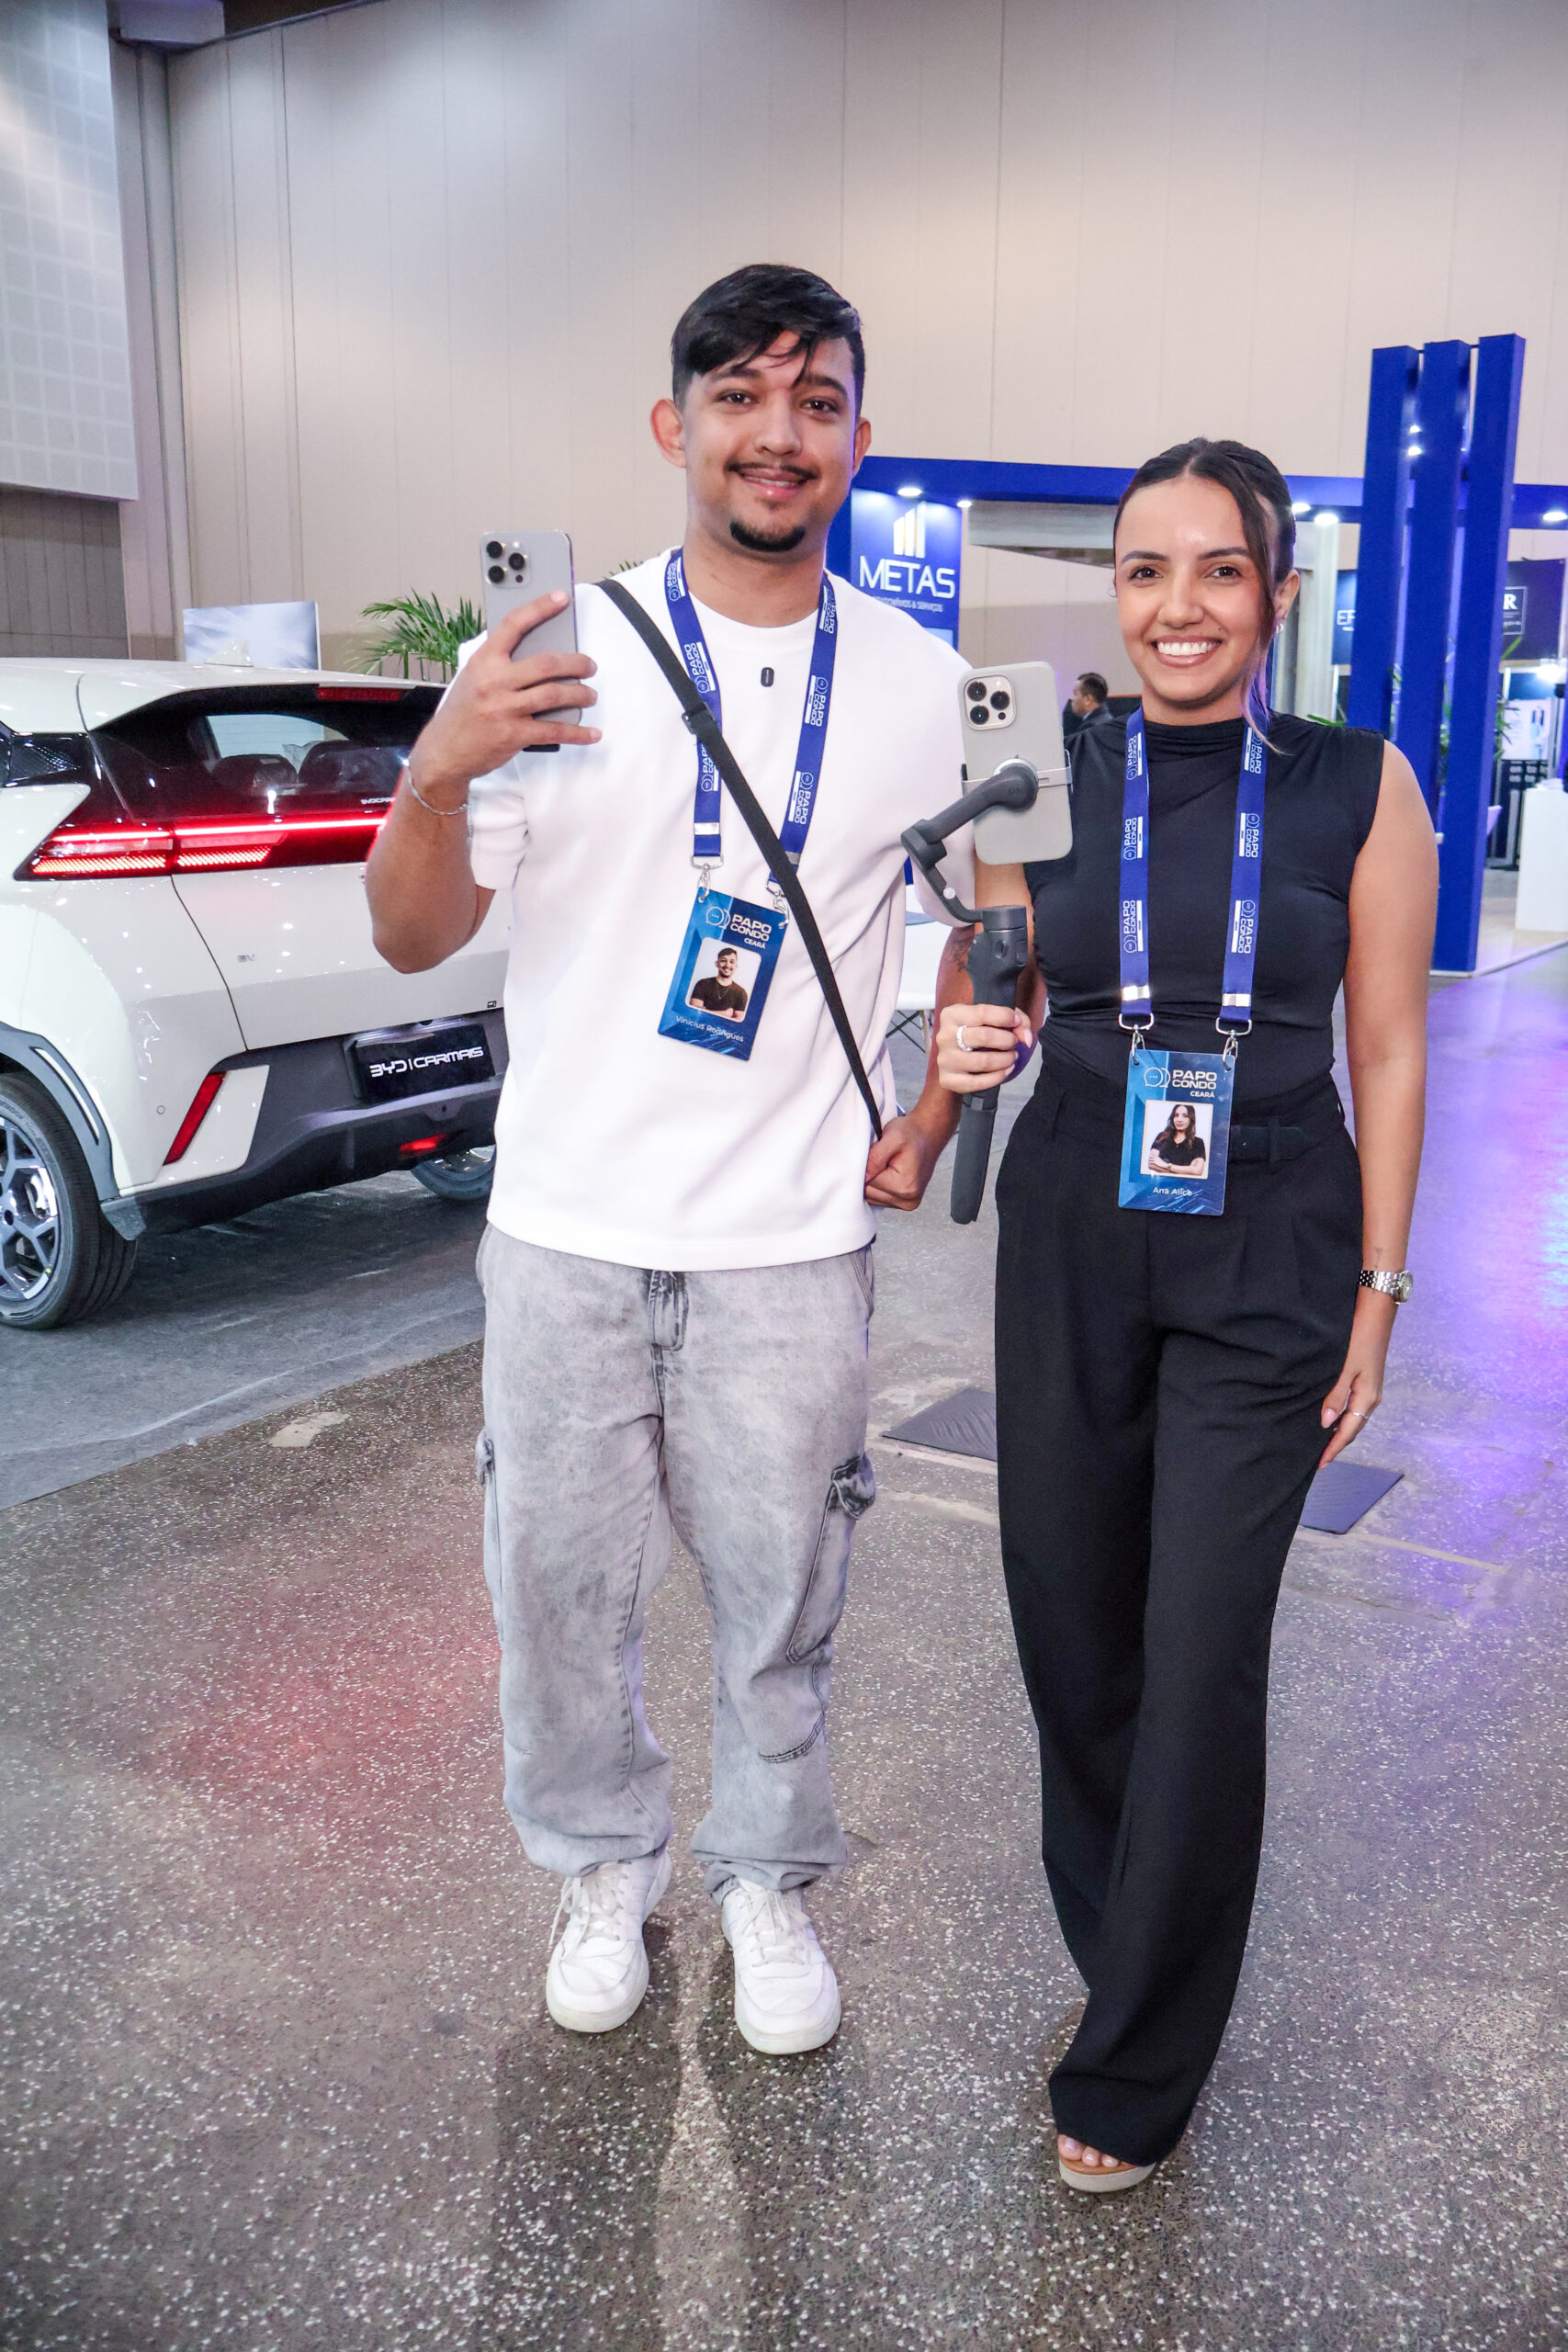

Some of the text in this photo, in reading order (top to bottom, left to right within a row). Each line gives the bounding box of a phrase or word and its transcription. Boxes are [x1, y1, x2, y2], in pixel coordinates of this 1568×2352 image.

[860, 555, 955, 599] METAS
[683, 644, 700, 676] PAPO
[691, 643, 705, 675] CONDO
[810, 694, 820, 726] CONDO
[815, 695, 827, 727] PAPO
[1254, 745, 1263, 775] PAPO
[794, 789, 805, 824] CONDO
[799, 790, 812, 825] PAPO
[1251, 829, 1259, 858] PAPO
[729, 922, 771, 942] CONDO
[732, 914, 773, 934] PAPO
[1122, 900, 1131, 934] PAPO
[744, 937, 767, 950] CEARÁ
[1237, 918, 1247, 954] CONDO
[1244, 918, 1255, 954] PAPO
[705, 1023, 744, 1043] Rodrigues
[369, 1046, 484, 1078] BYD CARMAIS
[1172, 1069, 1217, 1082] PAPO
[1171, 1080, 1217, 1091] CONDO
[1190, 1090, 1215, 1099] CEARÁ
[1153, 1186, 1192, 1197] Ana Alice
